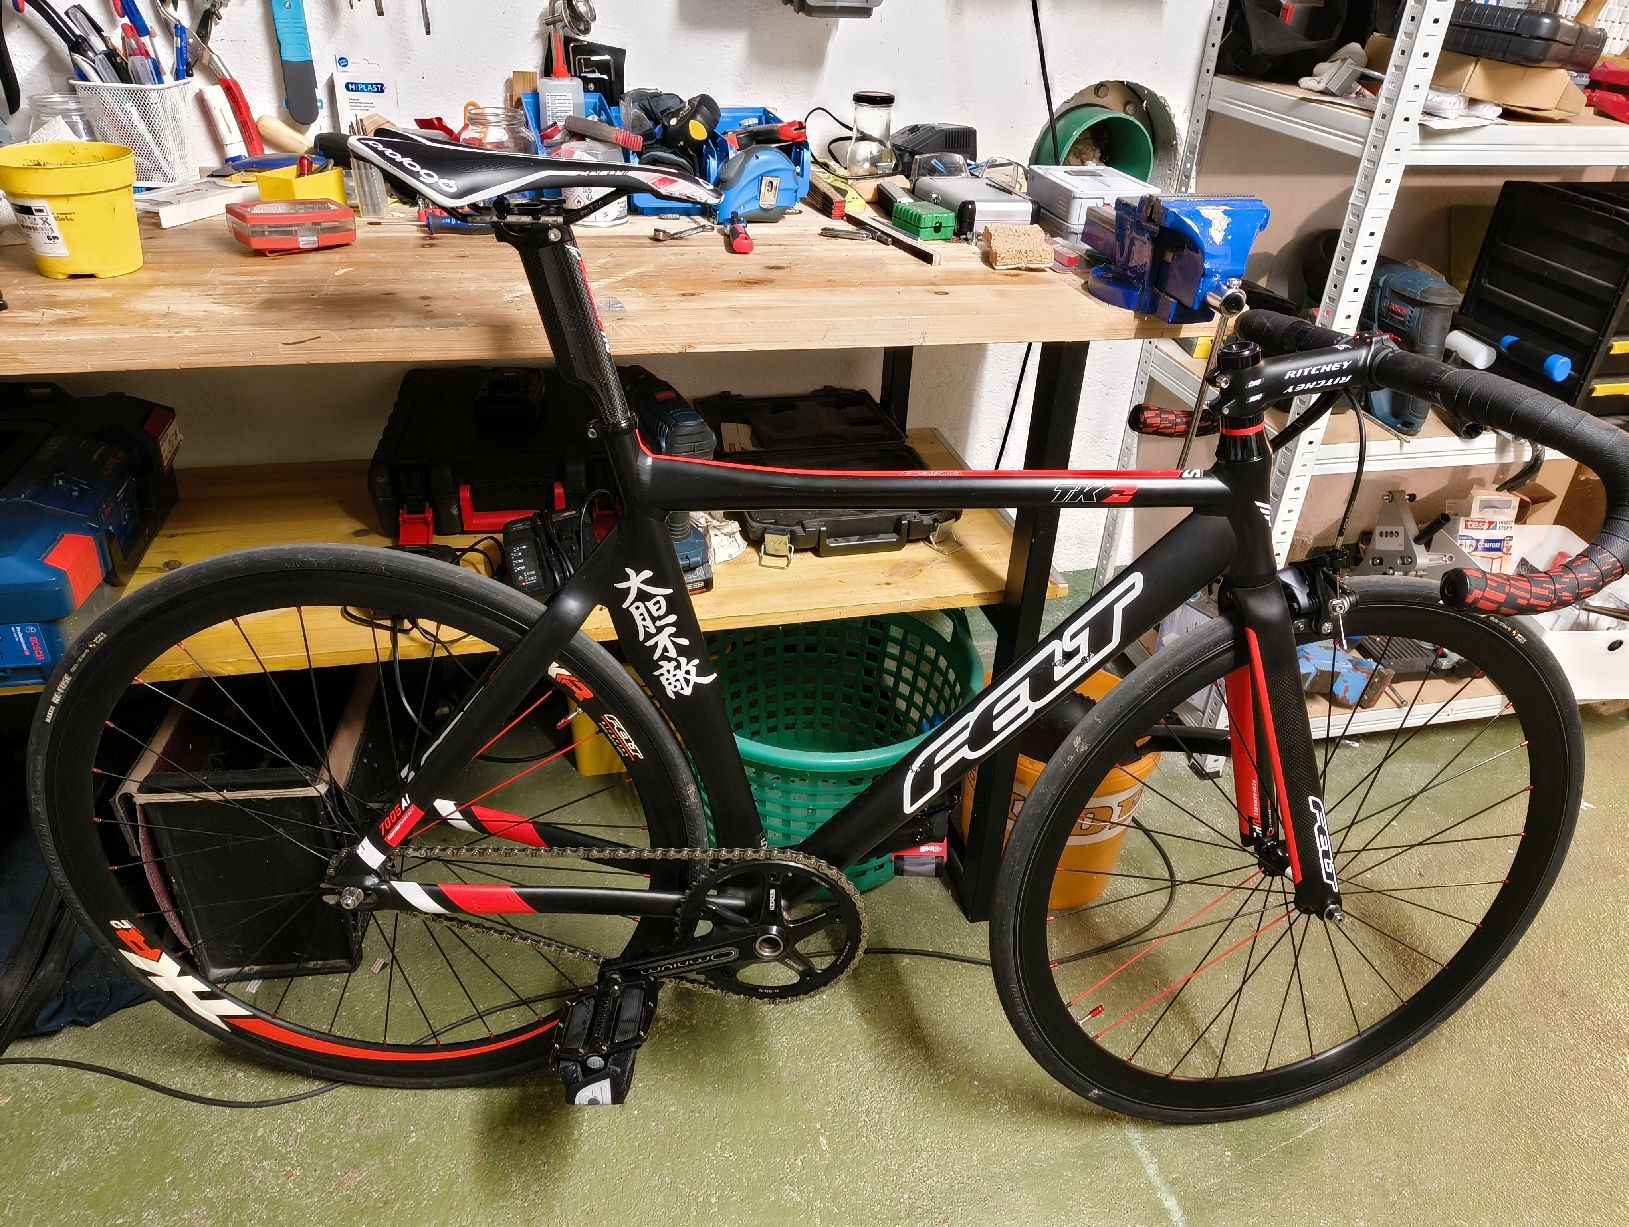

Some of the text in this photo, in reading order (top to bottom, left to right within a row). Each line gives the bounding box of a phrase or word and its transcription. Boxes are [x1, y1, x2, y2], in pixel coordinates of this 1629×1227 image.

[363, 139, 458, 193] prologo
[1284, 360, 1352, 380] RITCHEY
[1283, 375, 1352, 394] RITCHEY
[614, 567, 718, 700] 大胆不敵
[30, 636, 45, 661] BOSCH
